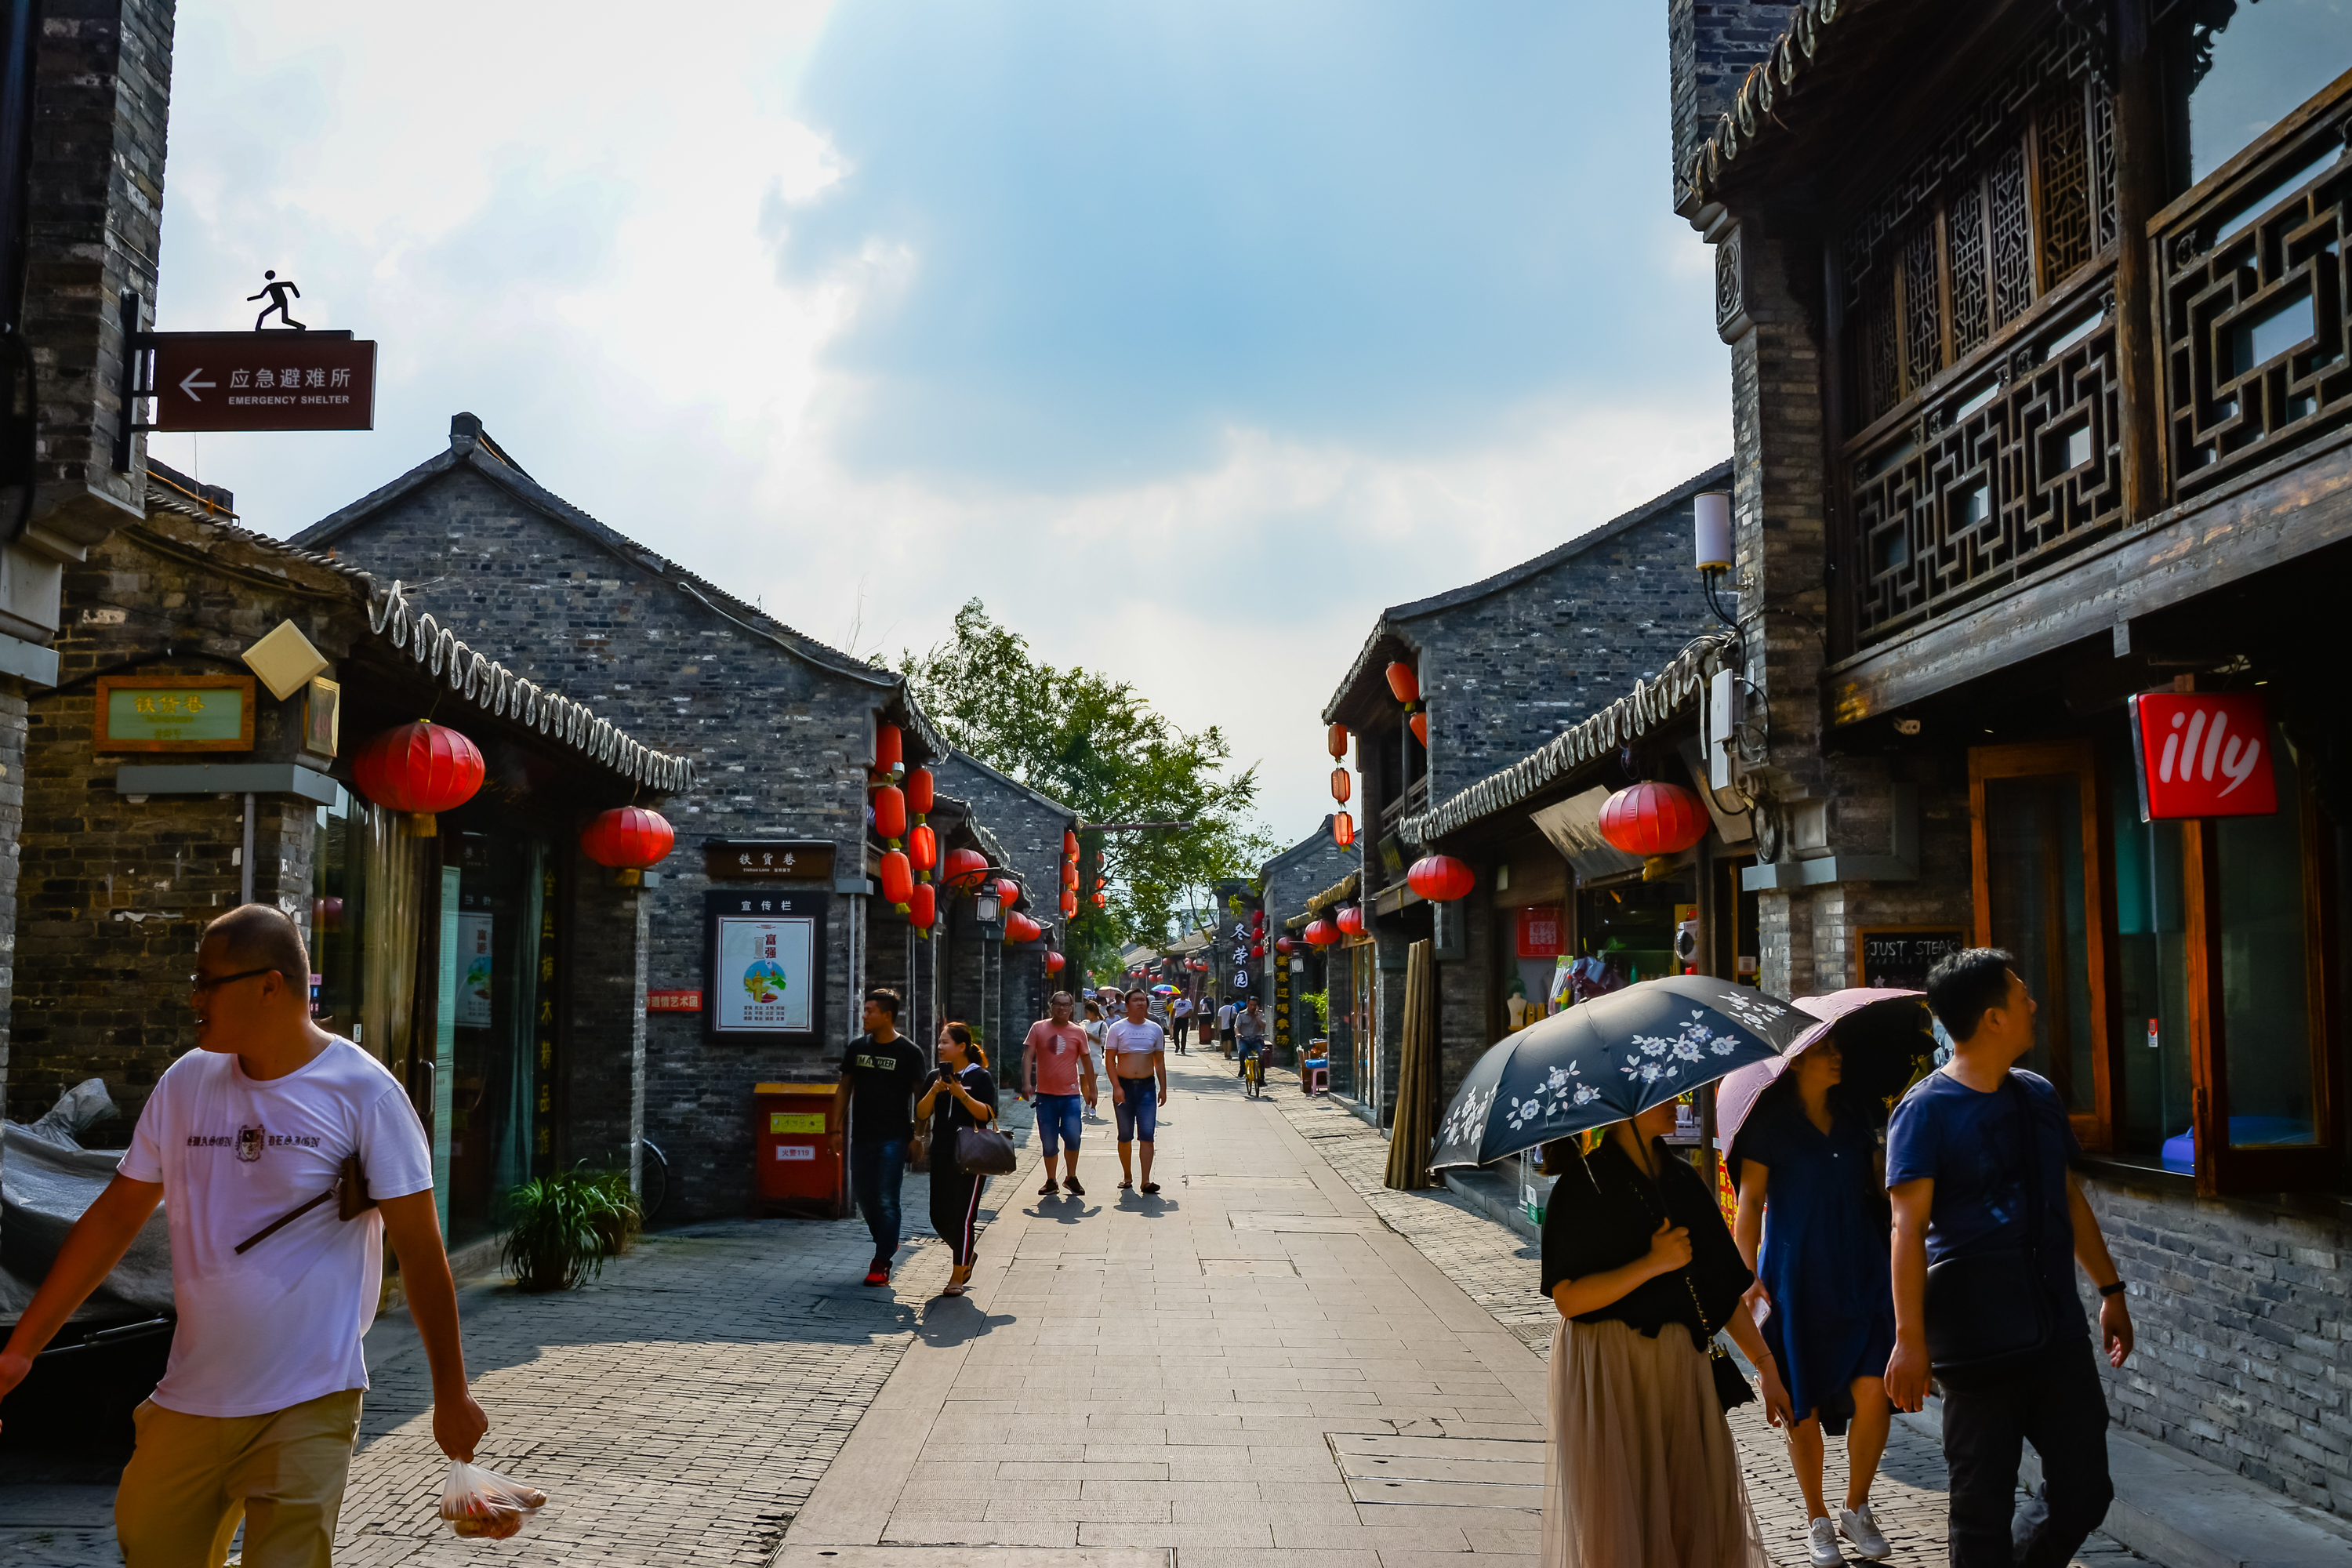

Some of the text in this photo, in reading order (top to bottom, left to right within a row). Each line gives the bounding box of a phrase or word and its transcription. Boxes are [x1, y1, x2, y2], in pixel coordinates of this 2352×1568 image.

[229, 368, 350, 389] 应急避难所
[228, 395, 350, 405] EMERGENCY SHELTER
[134, 695, 205, 713] 铁货巷
[2159, 709, 2261, 798] illy
[739, 852, 797, 866] 铁货巷
[741, 900, 792, 911] 宣传栏
[765, 934, 776, 959] 富强
[1870, 940, 1956, 956] JUST STEAK
[1230, 922, 1250, 989] 冬荣园
[876, 1058, 895, 1069] OXER
[268, 1136, 321, 1148] DESIGN
[782, 1149, 810, 1157] 火警119
